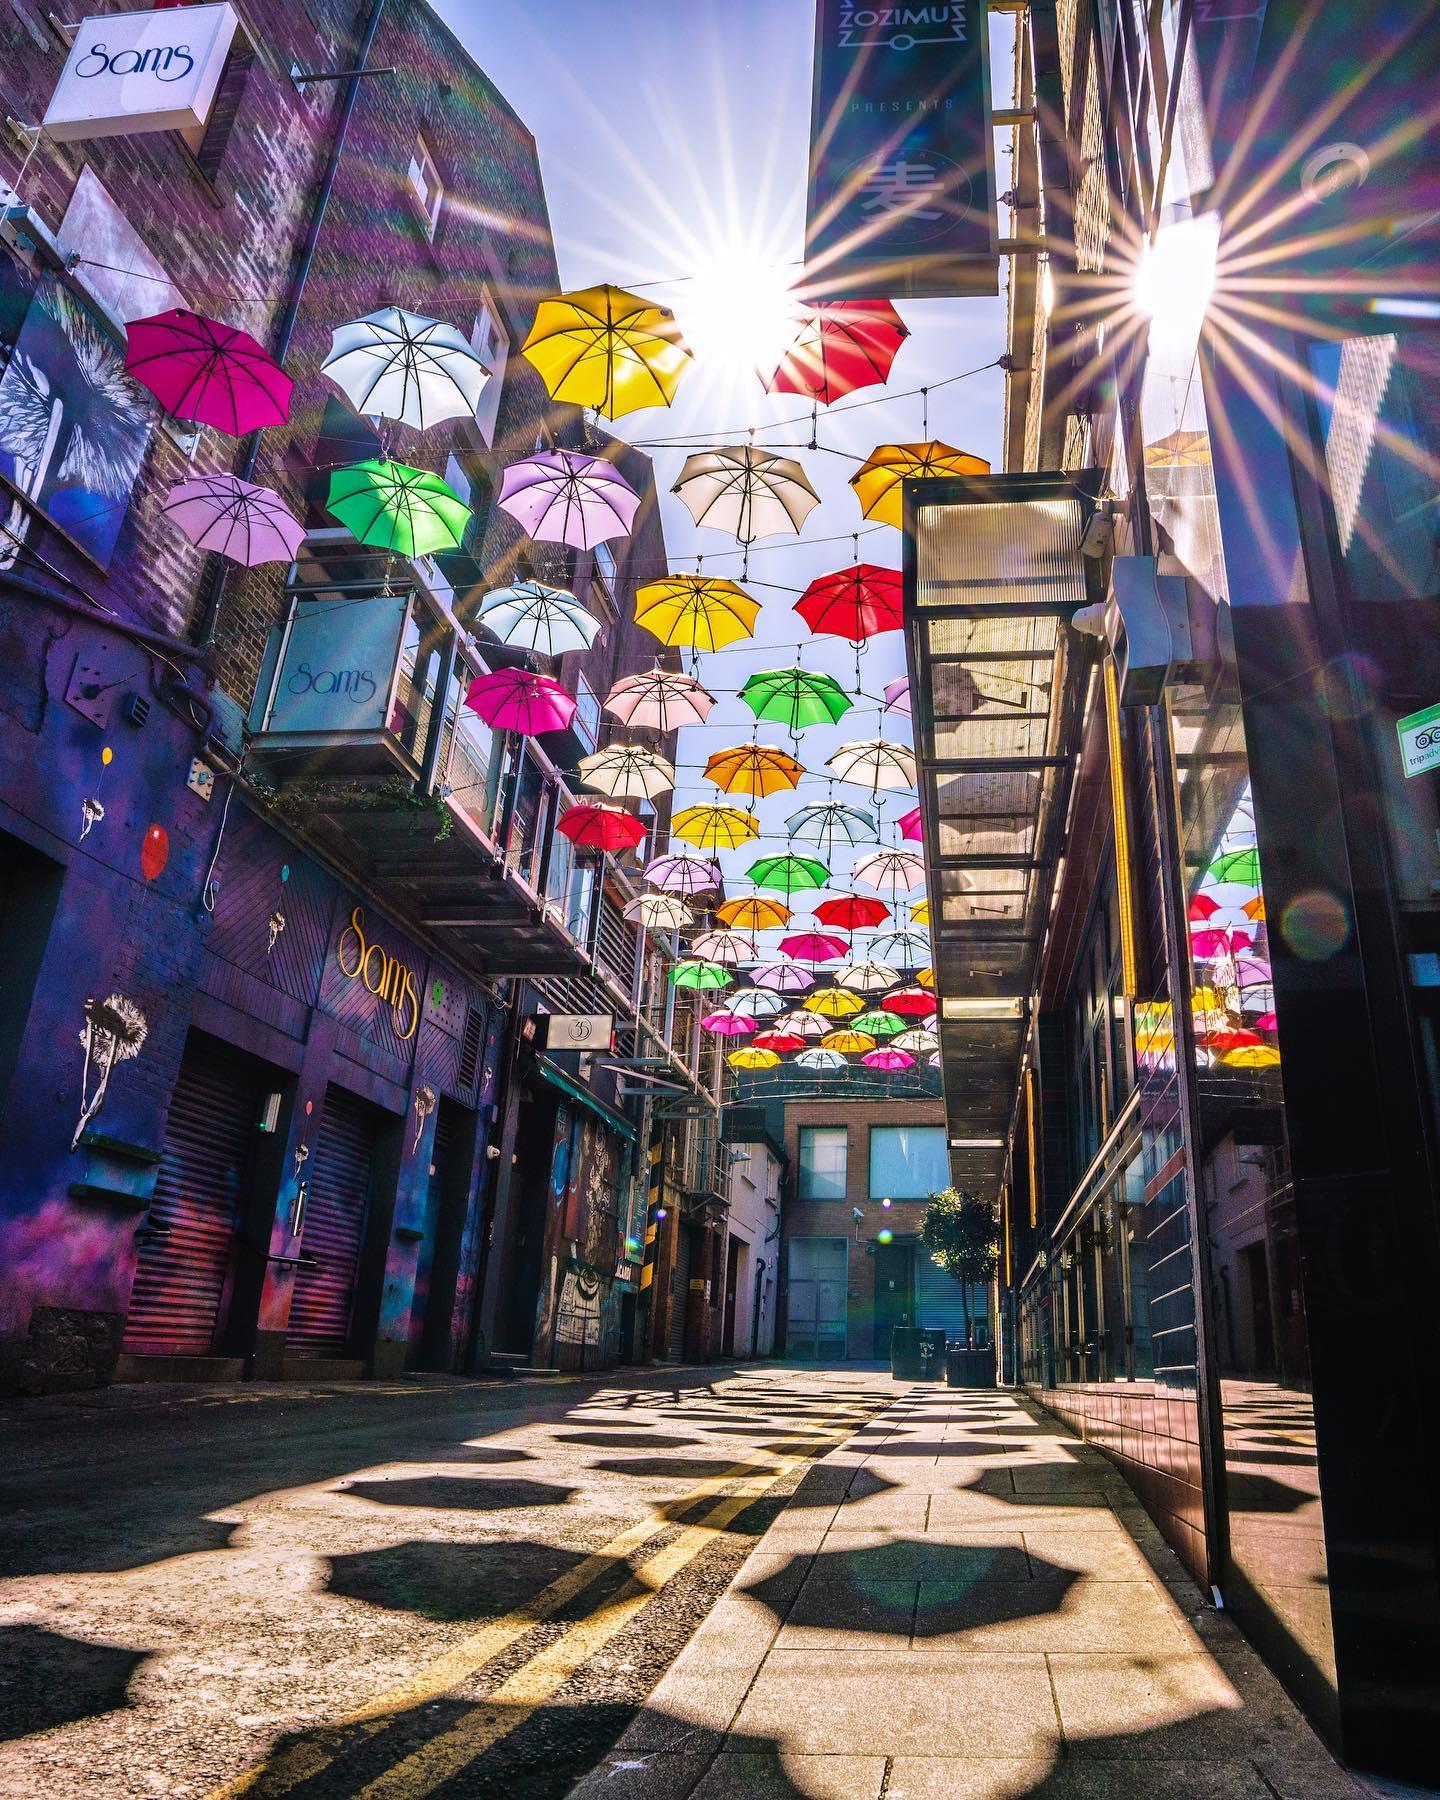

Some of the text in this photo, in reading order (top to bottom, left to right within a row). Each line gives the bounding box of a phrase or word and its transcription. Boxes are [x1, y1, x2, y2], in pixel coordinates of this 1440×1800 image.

[75, 43, 194, 82] Sams
[851, 99, 953, 113] PRESENTS
[287, 662, 377, 704] Sams
[339, 907, 418, 1040] Sams
